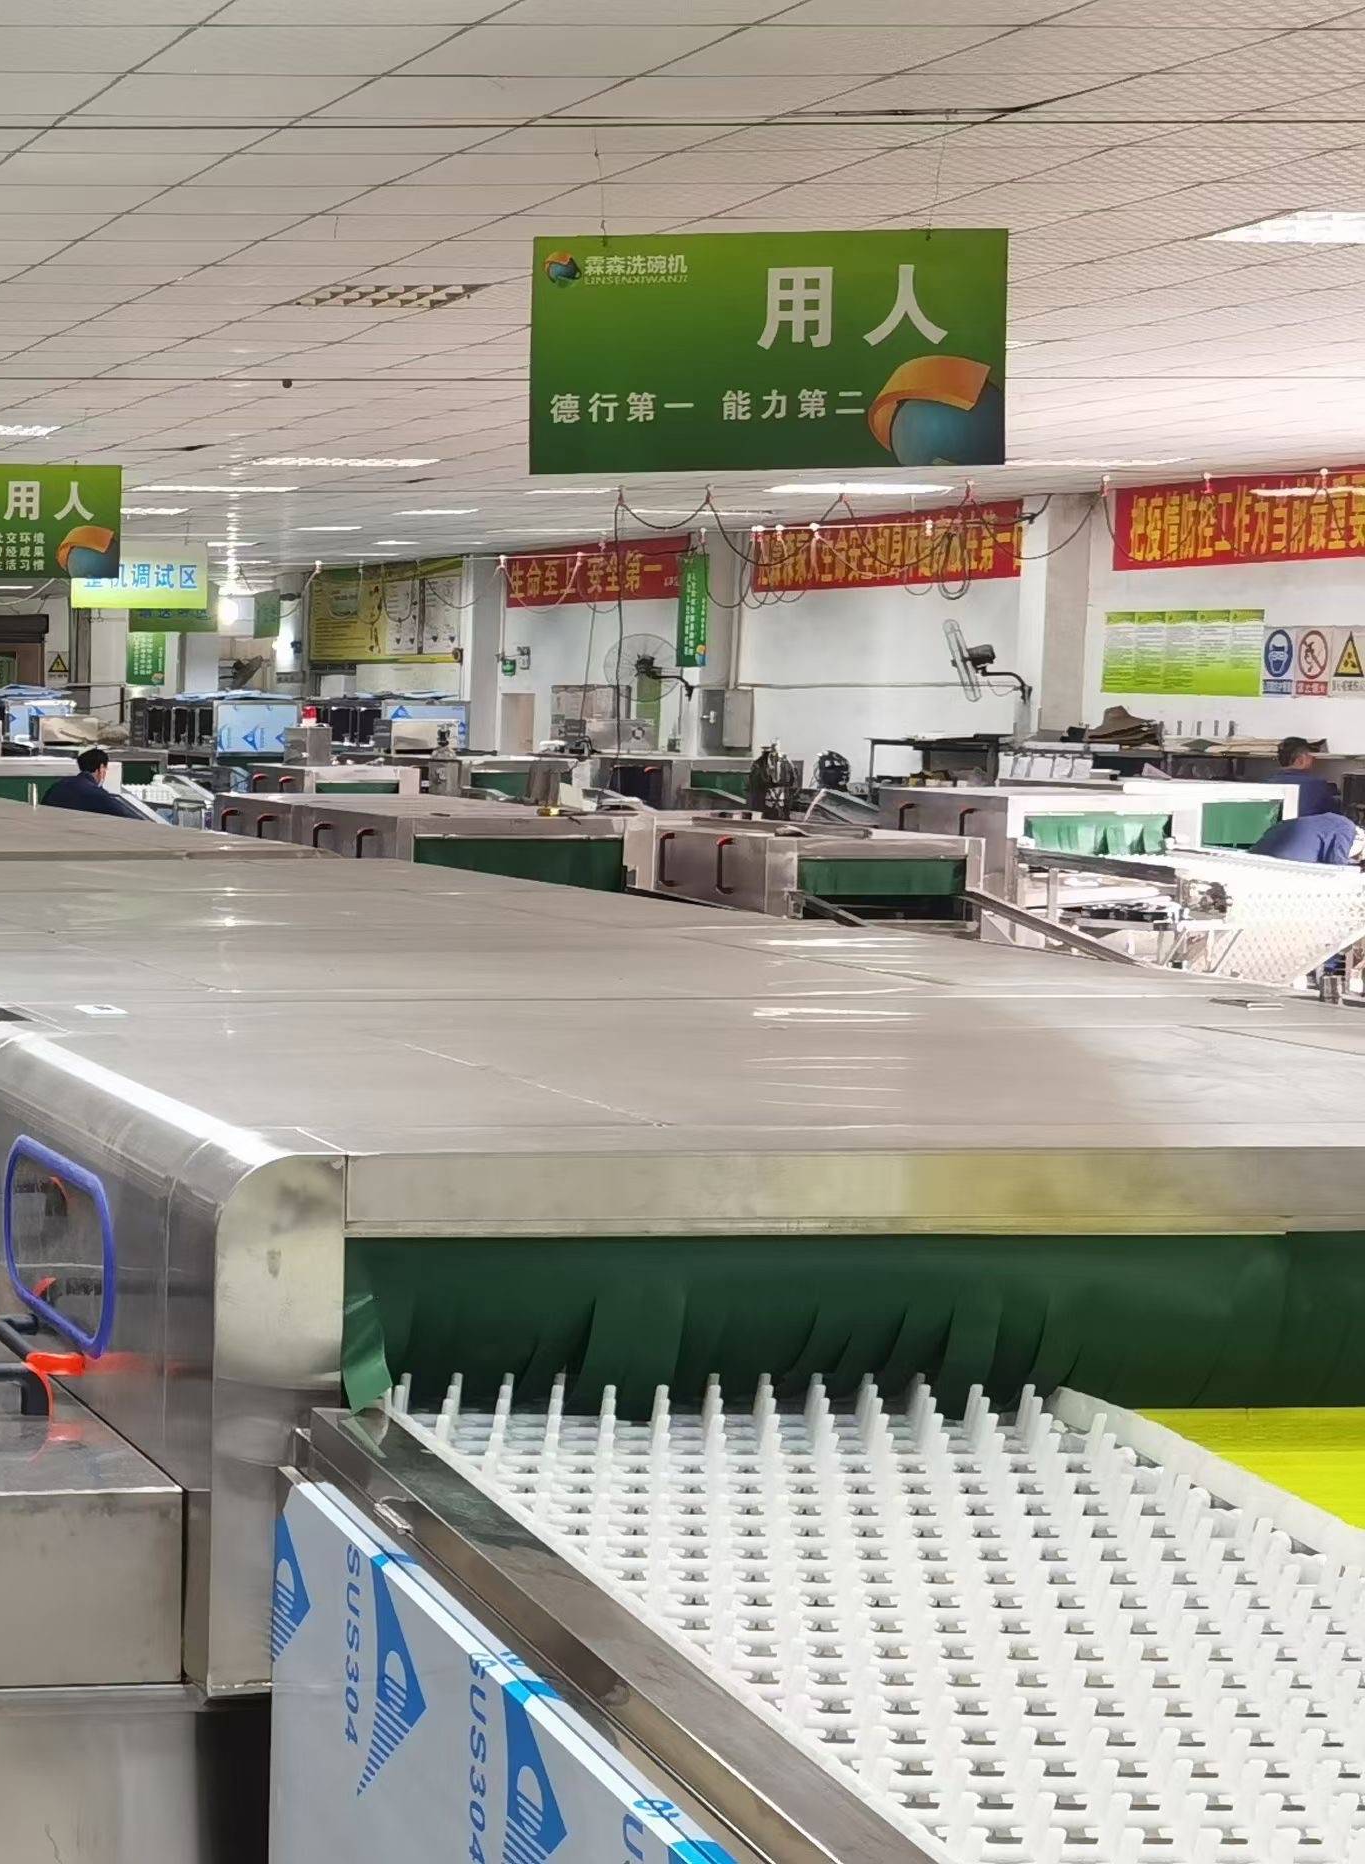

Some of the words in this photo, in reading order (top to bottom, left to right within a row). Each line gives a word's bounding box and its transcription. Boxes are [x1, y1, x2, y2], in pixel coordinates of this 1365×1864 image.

[584, 254, 688, 276] 霖森洗碗机
[584, 275, 688, 285] LINSENXIWANJI
[757, 264, 948, 350] 用人
[549, 392, 694, 424] 德行第一
[722, 388, 865, 421] 能力第二
[3, 481, 94, 520] 用人
[510, 558, 576, 598] 生命至上
[587, 550, 662, 594] 安全第一
[345, 1543, 361, 1745] SUS304
[469, 1653, 488, 1864] SUS304
